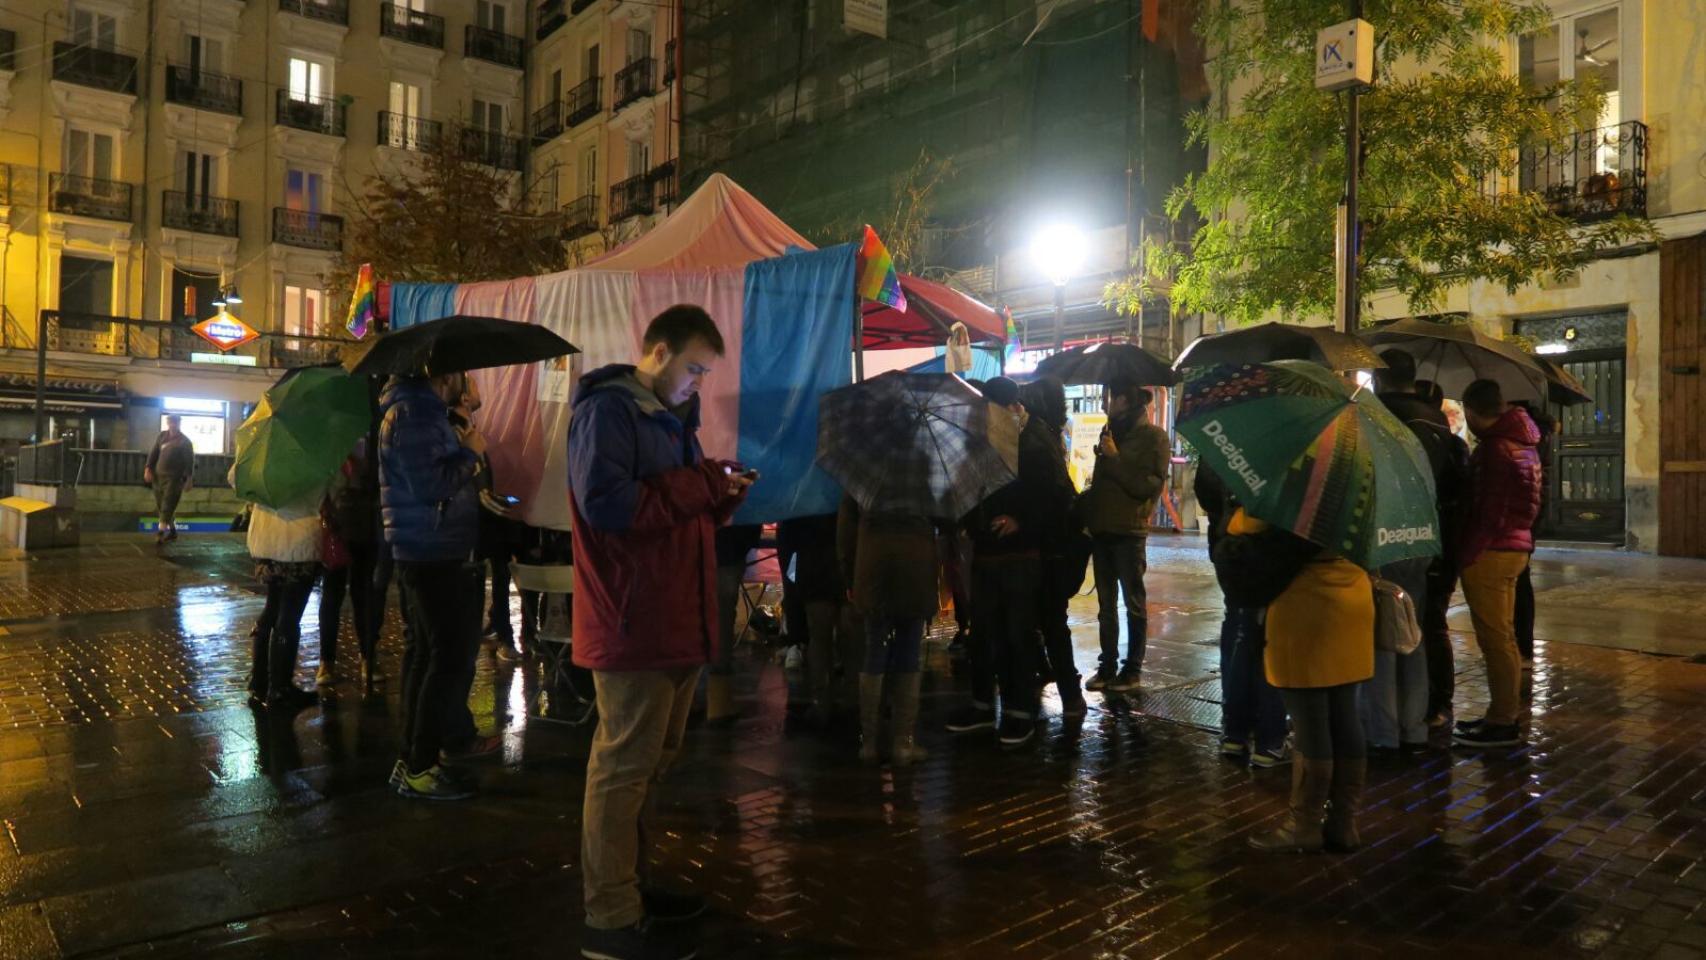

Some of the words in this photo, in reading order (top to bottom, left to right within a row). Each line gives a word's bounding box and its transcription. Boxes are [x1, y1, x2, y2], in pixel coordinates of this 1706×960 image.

[211, 325, 241, 337] Metro
[1202, 420, 1267, 494] Desigual
[1378, 523, 1433, 546] Desigual
